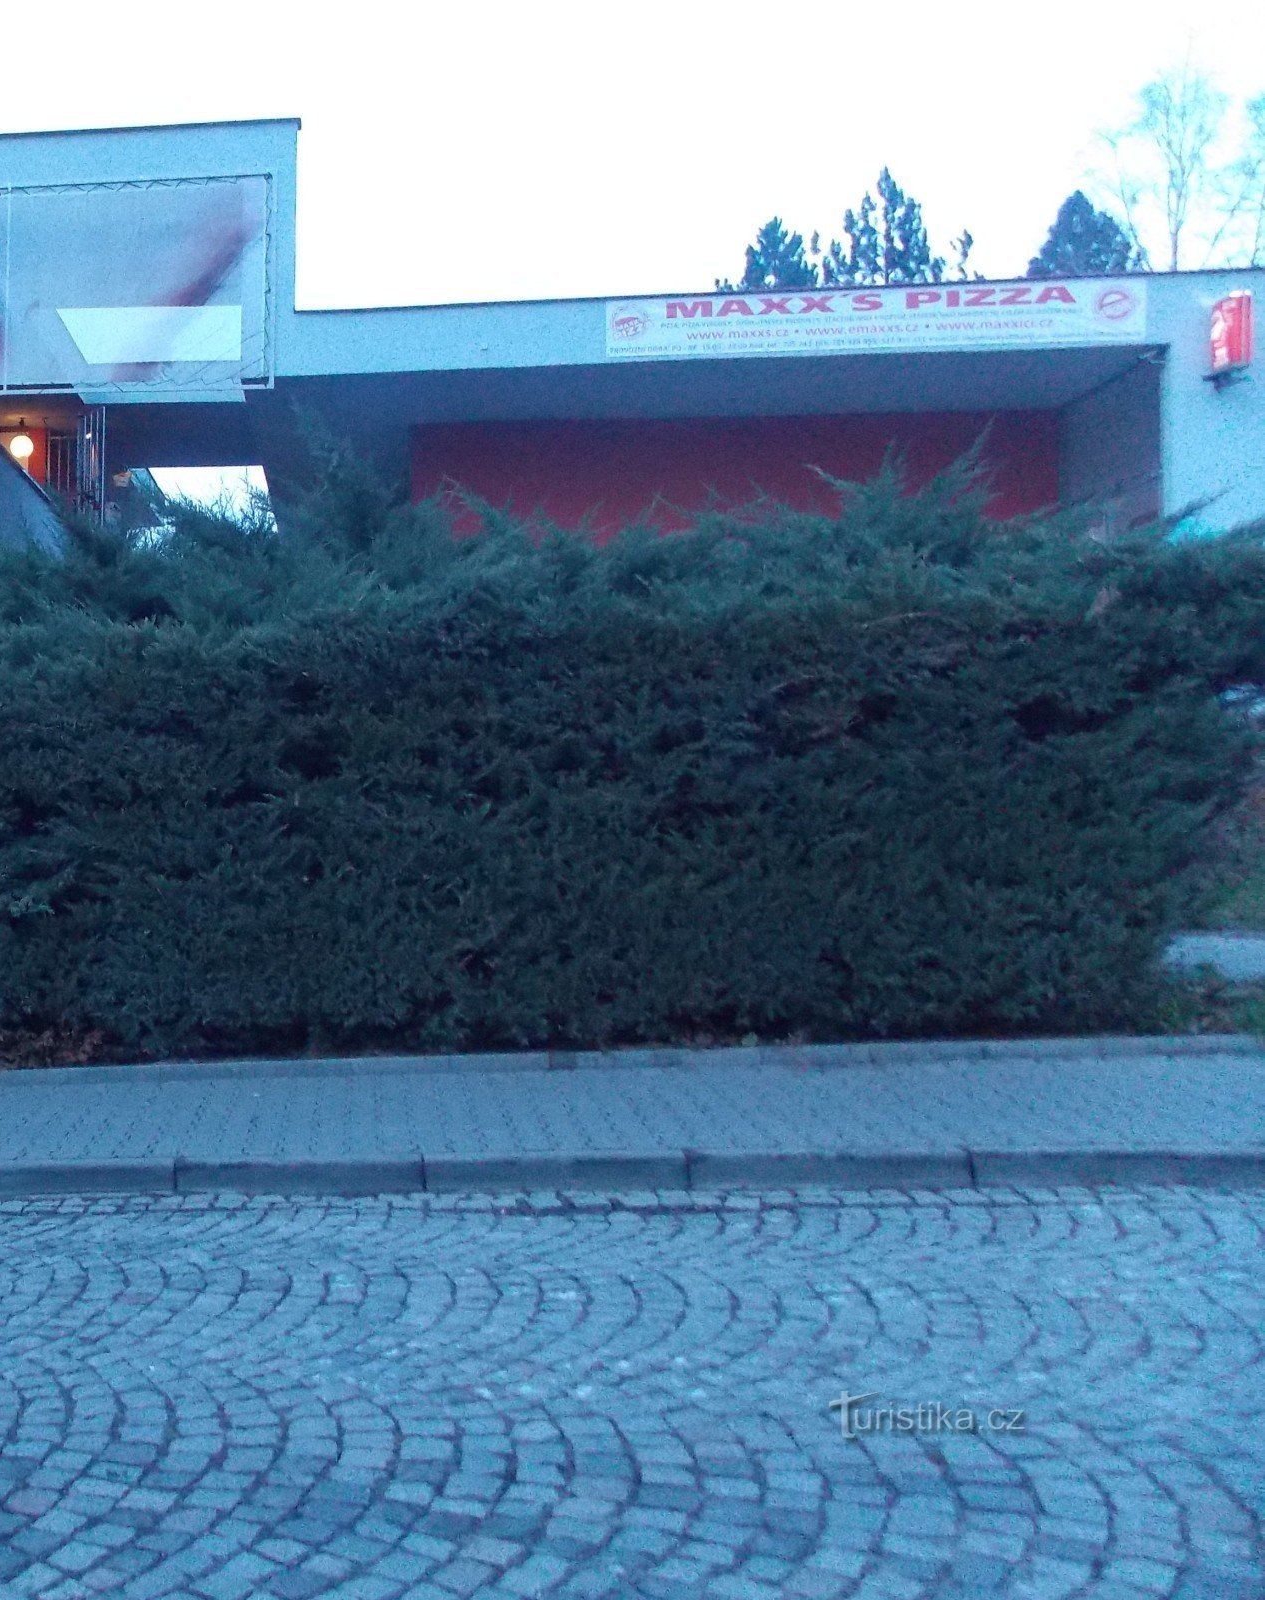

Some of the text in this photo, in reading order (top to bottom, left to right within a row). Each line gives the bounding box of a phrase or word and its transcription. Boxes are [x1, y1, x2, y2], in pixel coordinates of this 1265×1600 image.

[905, 286, 1077, 310] PIZZA
[686, 327, 789, 341] www.maxxs.cz
[805, 322, 919, 337] www.emaxxs.cz
